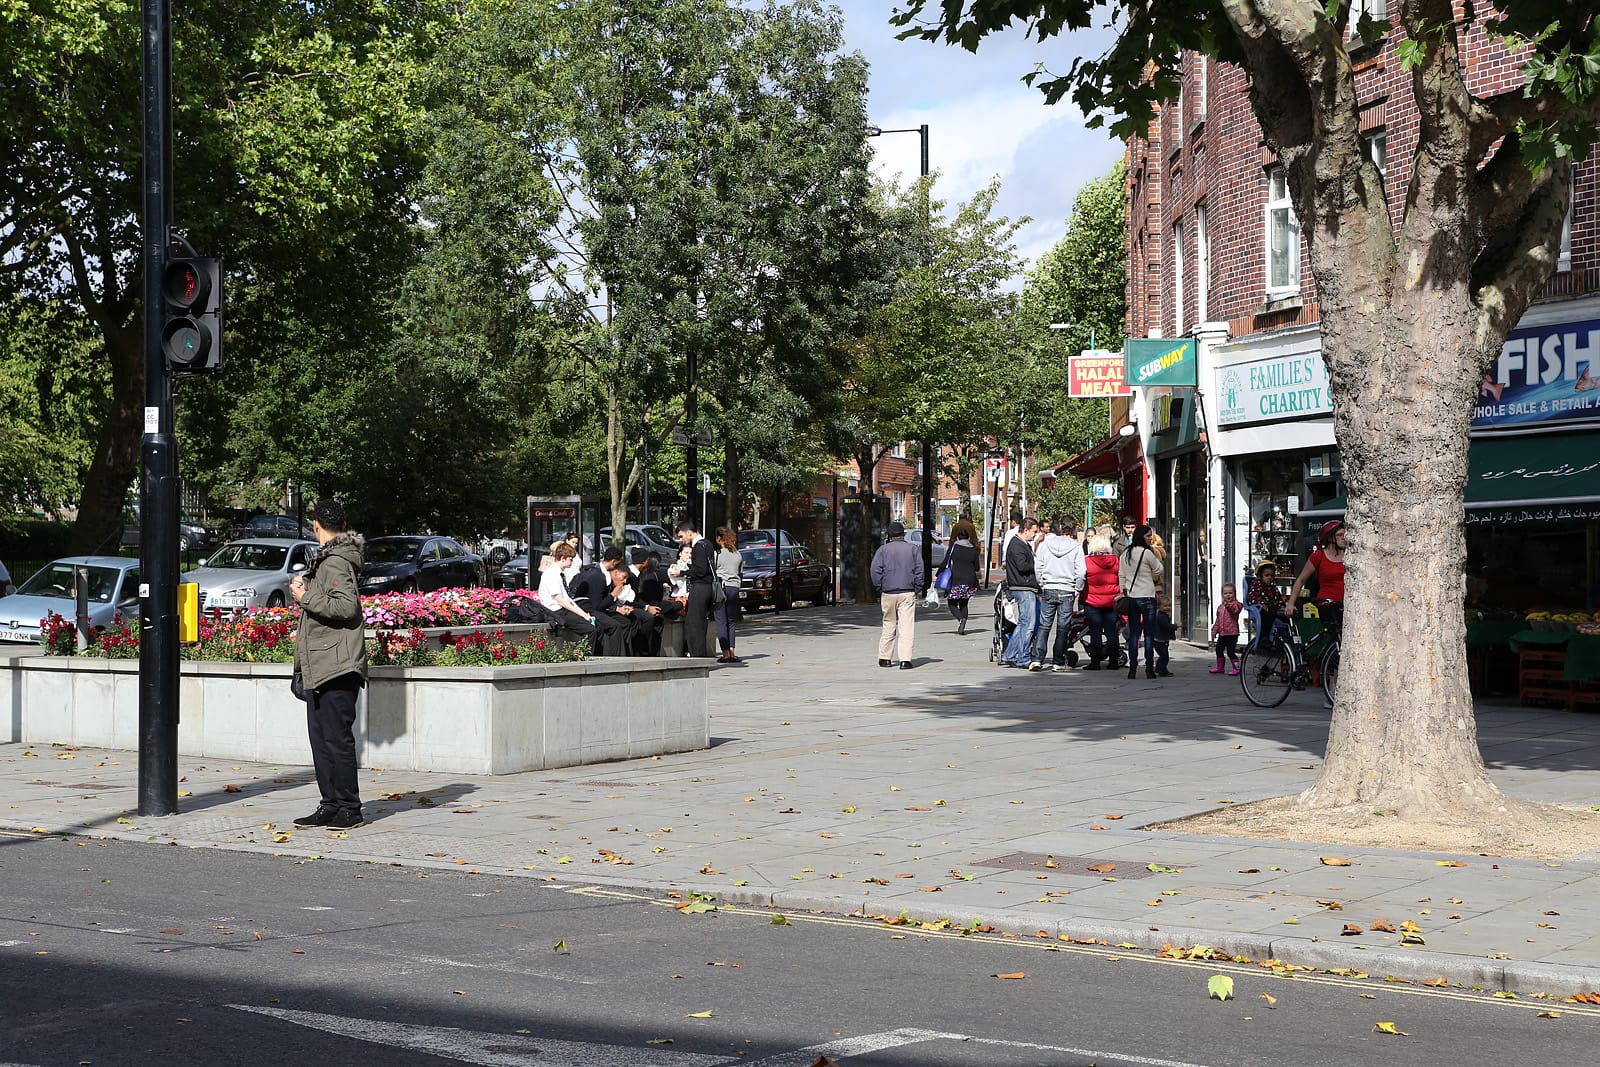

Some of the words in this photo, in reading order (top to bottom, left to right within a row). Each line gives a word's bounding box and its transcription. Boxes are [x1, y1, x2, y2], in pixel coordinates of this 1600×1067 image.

[1138, 343, 1189, 381] SUBWAY
[1498, 330, 1600, 388] FISH
[1076, 367, 1124, 380] HALAL
[1250, 357, 1314, 390] FAMILIES'
[1081, 382, 1121, 395] MEAT
[1260, 387, 1321, 415] CHARITY
[1508, 402, 1537, 416] SALE
[1540, 401, 1549, 412] &
[1552, 396, 1592, 411] RETAIL
